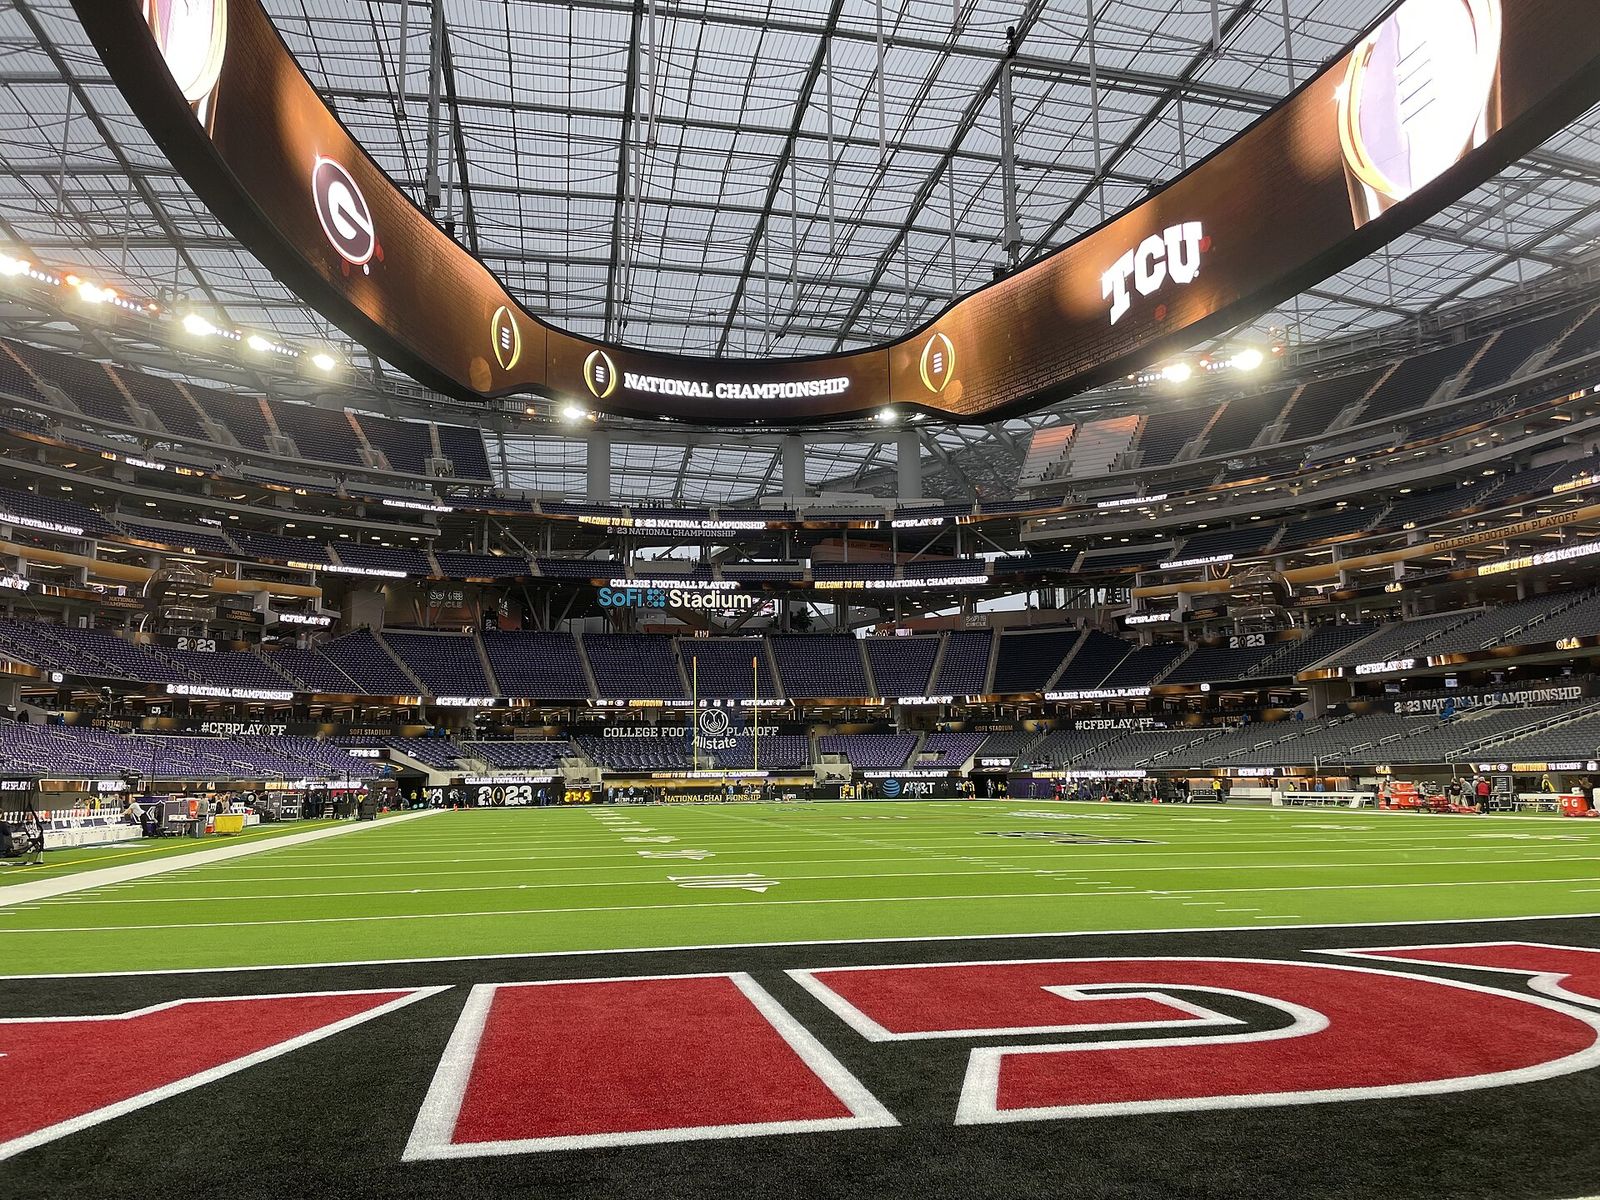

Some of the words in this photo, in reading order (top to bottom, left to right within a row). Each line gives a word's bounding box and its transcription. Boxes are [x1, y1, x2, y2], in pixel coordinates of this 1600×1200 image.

[1101, 221, 1202, 325] TCU
[623, 372, 714, 397] NATIONAL
[715, 377, 850, 399] CHAMPIONSHIP
[0, 513, 20, 524] LLEGE
[20, 518, 54, 530] FOOTBALL
[54, 522, 84, 536] PLAYOFF
[578, 516, 611, 525] WELCOME
[612, 518, 620, 526] TO
[620, 518, 634, 526] THE
[657, 520, 700, 528] NATIONAL
[701, 520, 766, 530] CHAMPIONSHIP
[672, 529, 736, 537] CHAMPIONSHIP
[1434, 535, 1476, 552] COLLEGE
[1478, 524, 1530, 542] FOOTBALL
[1532, 512, 1578, 530] PLAYOFF
[1558, 542, 1600, 560] NATIONA
[610, 580, 650, 588] COLLEGE
[651, 580, 698, 588] FOOTBALL
[698, 581, 738, 590] PLAYOFF
[886, 578, 926, 588] NATIONAL
[926, 576, 988, 586] CHAMPIONSHIP
[599, 588, 642, 607] SoFi
[669, 589, 752, 608] Stadium
[177, 637, 216, 652] 2023
[1230, 634, 1265, 649] 2023
[189, 686, 232, 697] NATIONAL
[232, 688, 294, 700] CHAMPIONSHIP
[1079, 690, 1117, 699] FOOTBALL
[1118, 688, 1151, 697] PLAYOFF
[201, 722, 286, 736] #CFBPLAYOFF
[604, 727, 658, 738] COLLEGE
[726, 726, 779, 736] PLAYOFF
[691, 736, 736, 750] Allstate
[478, 786, 532, 806] 2023
